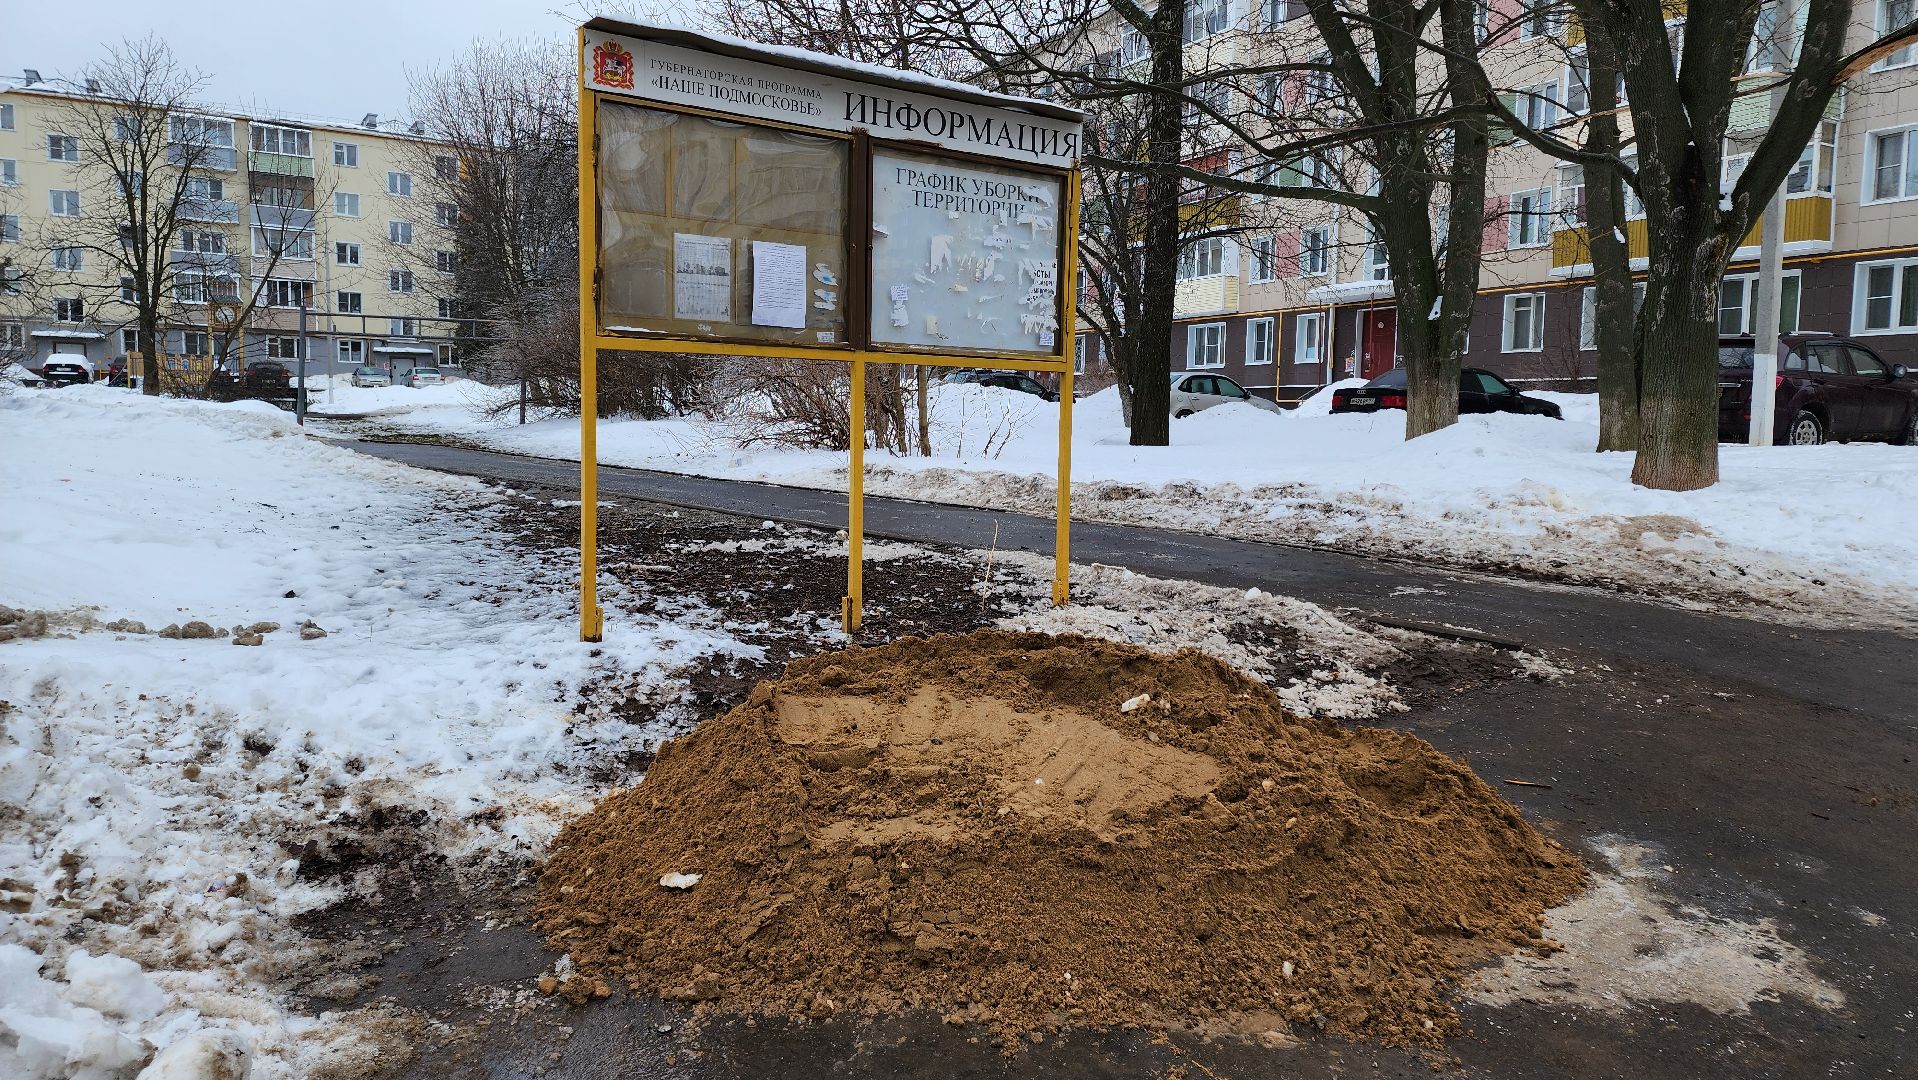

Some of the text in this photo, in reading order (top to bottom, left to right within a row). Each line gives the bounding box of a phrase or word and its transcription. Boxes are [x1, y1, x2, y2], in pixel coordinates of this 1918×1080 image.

[651, 75, 822, 117] «НАШЕ ПОДМОСКОВЬЕ»
[758, 79, 823, 100] ПРОГРАММА
[843, 91, 1079, 159] ИНФОРМАЦИЯ
[896, 167, 967, 194] ГРАФИК
